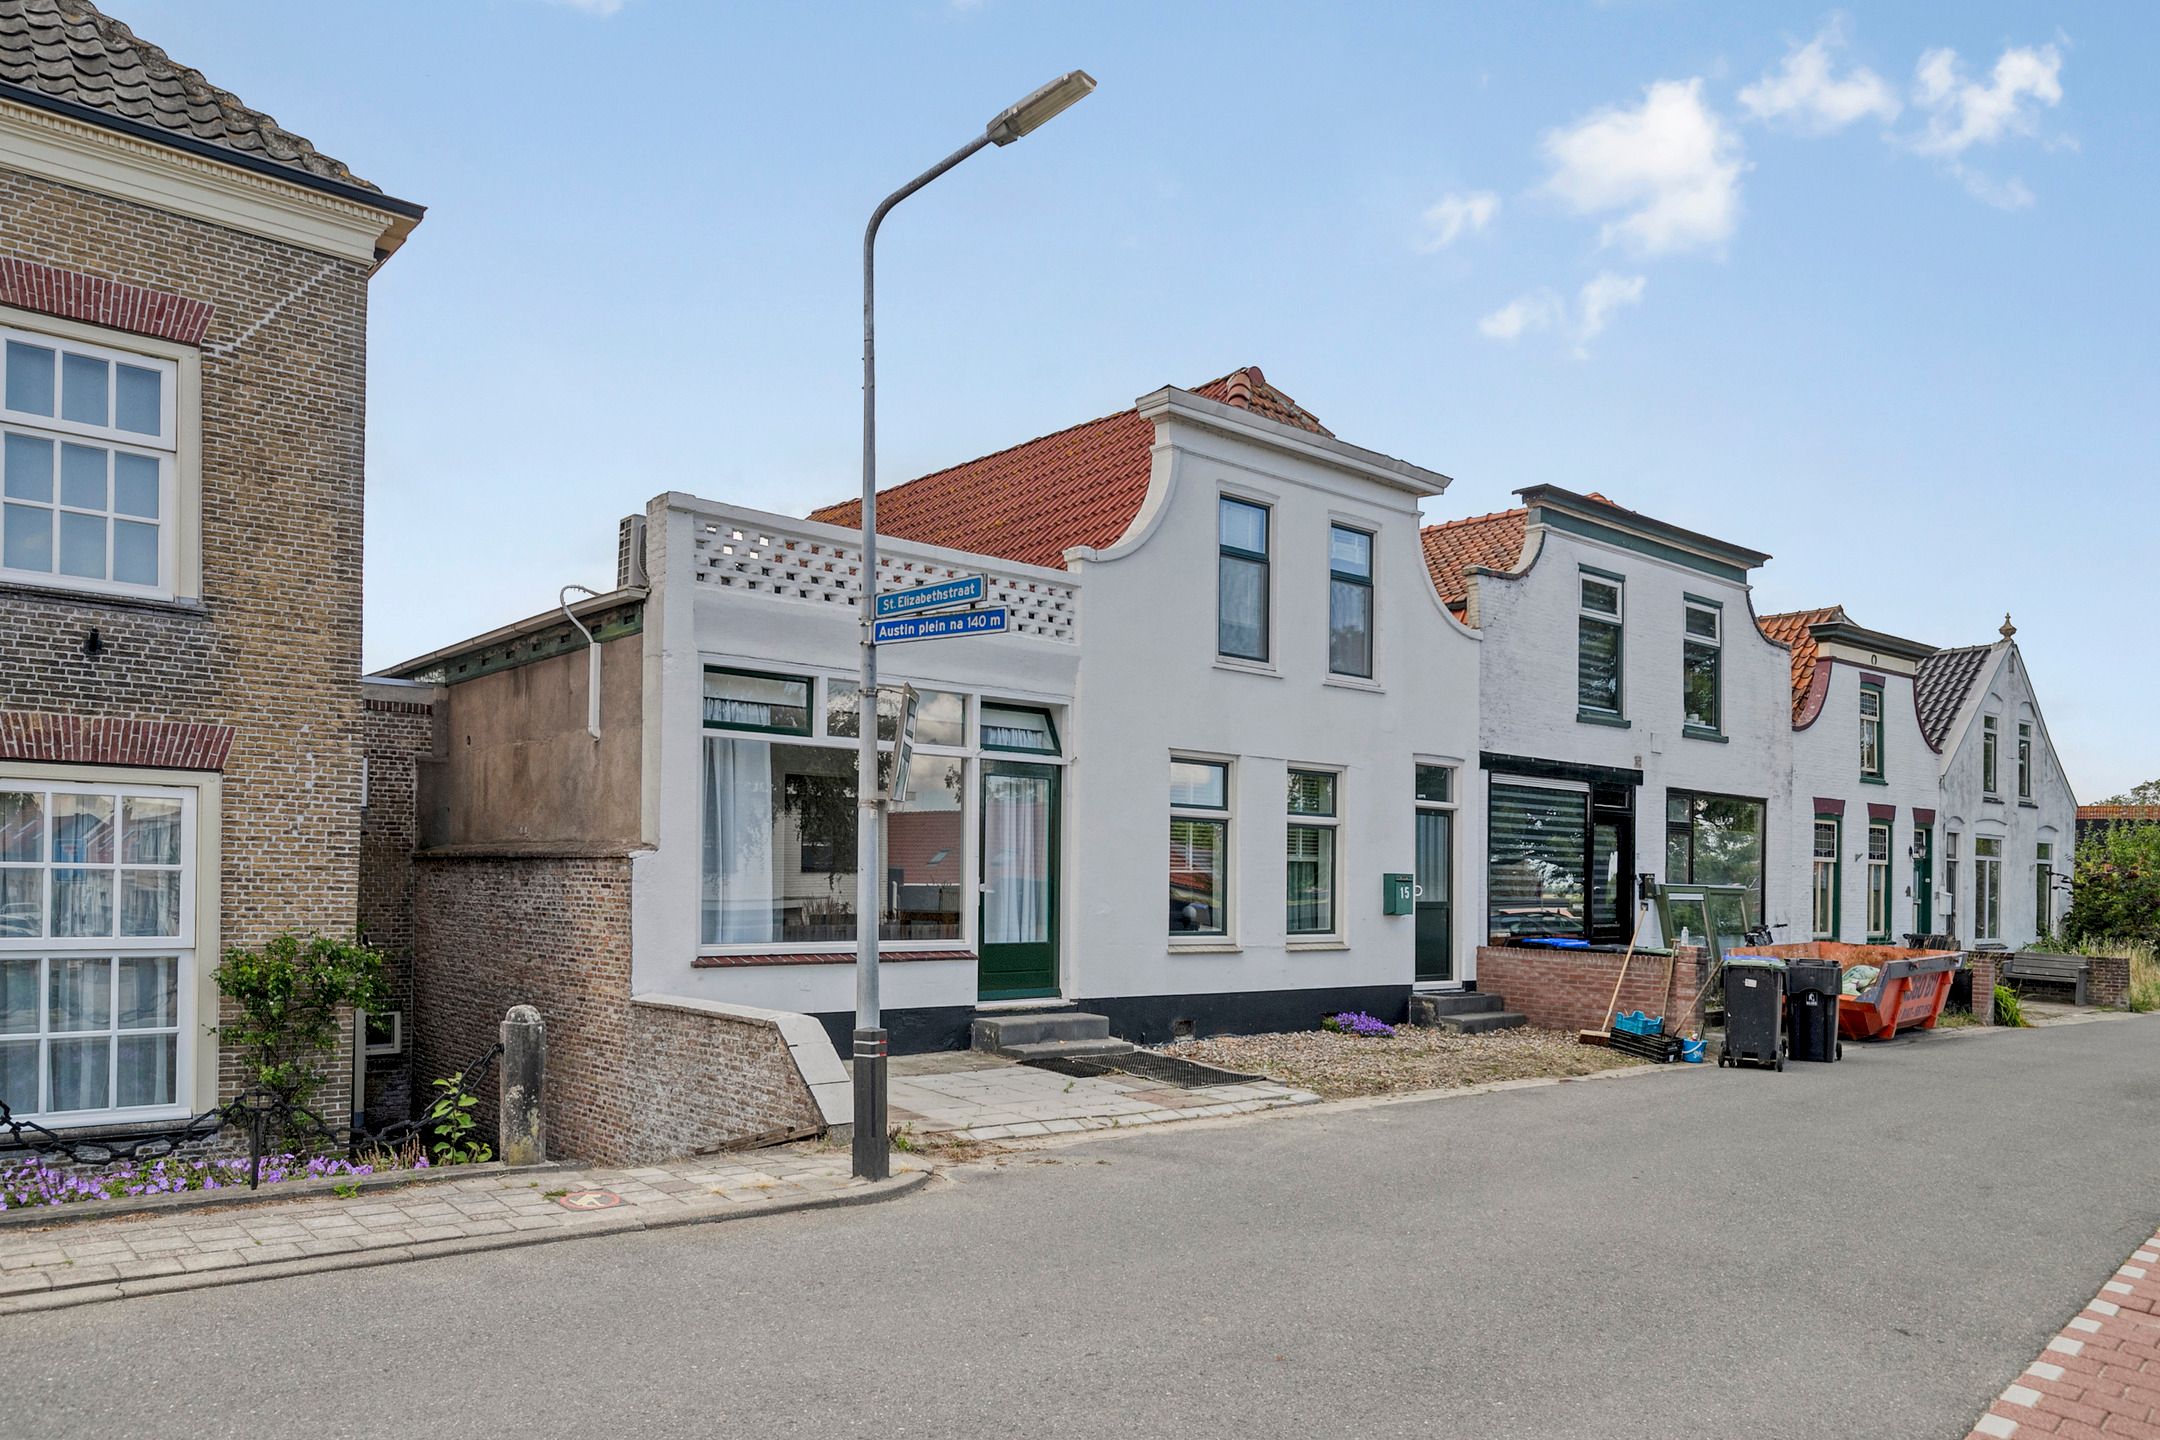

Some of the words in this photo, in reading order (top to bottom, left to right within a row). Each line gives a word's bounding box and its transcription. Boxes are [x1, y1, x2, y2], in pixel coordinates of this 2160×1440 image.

[883, 598, 897, 611] St.
[898, 583, 975, 608] Elizabethstraat
[879, 624, 915, 637] Austin
[918, 620, 946, 635] plein
[950, 621, 963, 631] na
[967, 614, 987, 628] 140
[990, 617, 1000, 626] m
[1400, 886, 1410, 899] 15
